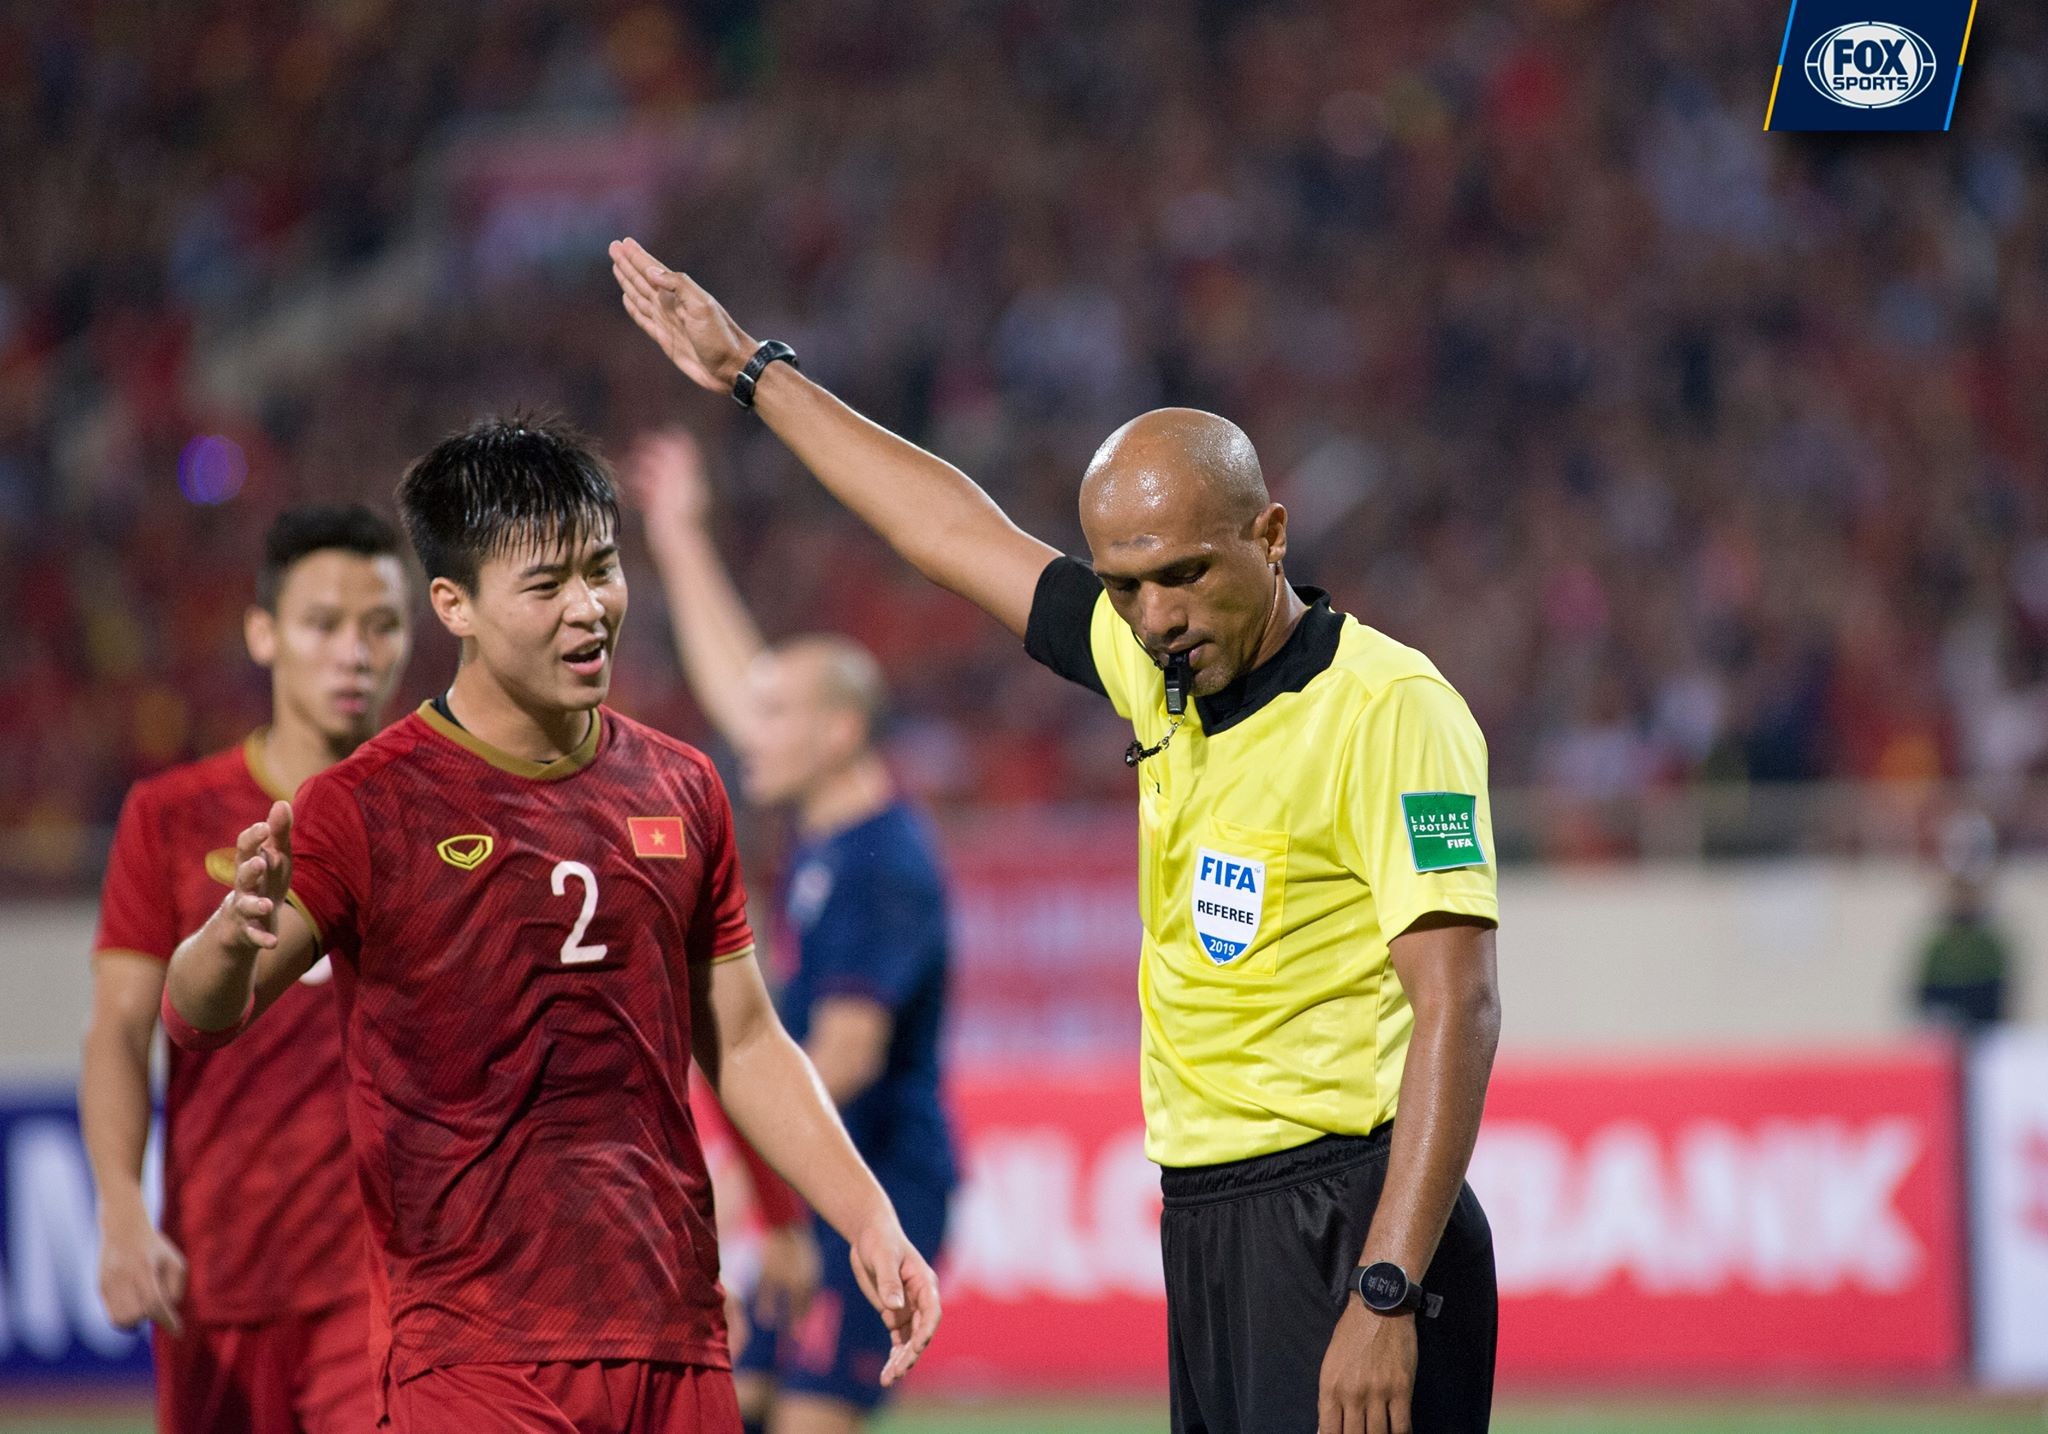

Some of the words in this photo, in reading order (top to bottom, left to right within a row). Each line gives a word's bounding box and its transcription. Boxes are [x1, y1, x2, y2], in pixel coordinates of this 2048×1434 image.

[1410, 812, 1469, 824] LIVING
[1412, 821, 1470, 833] FOOTBALL
[1446, 838, 1474, 849] FIFA
[1200, 856, 1256, 893] FIFA
[550, 860, 608, 964] 2
[1197, 899, 1254, 925] REFEREE
[1209, 939, 1236, 956] 2019
